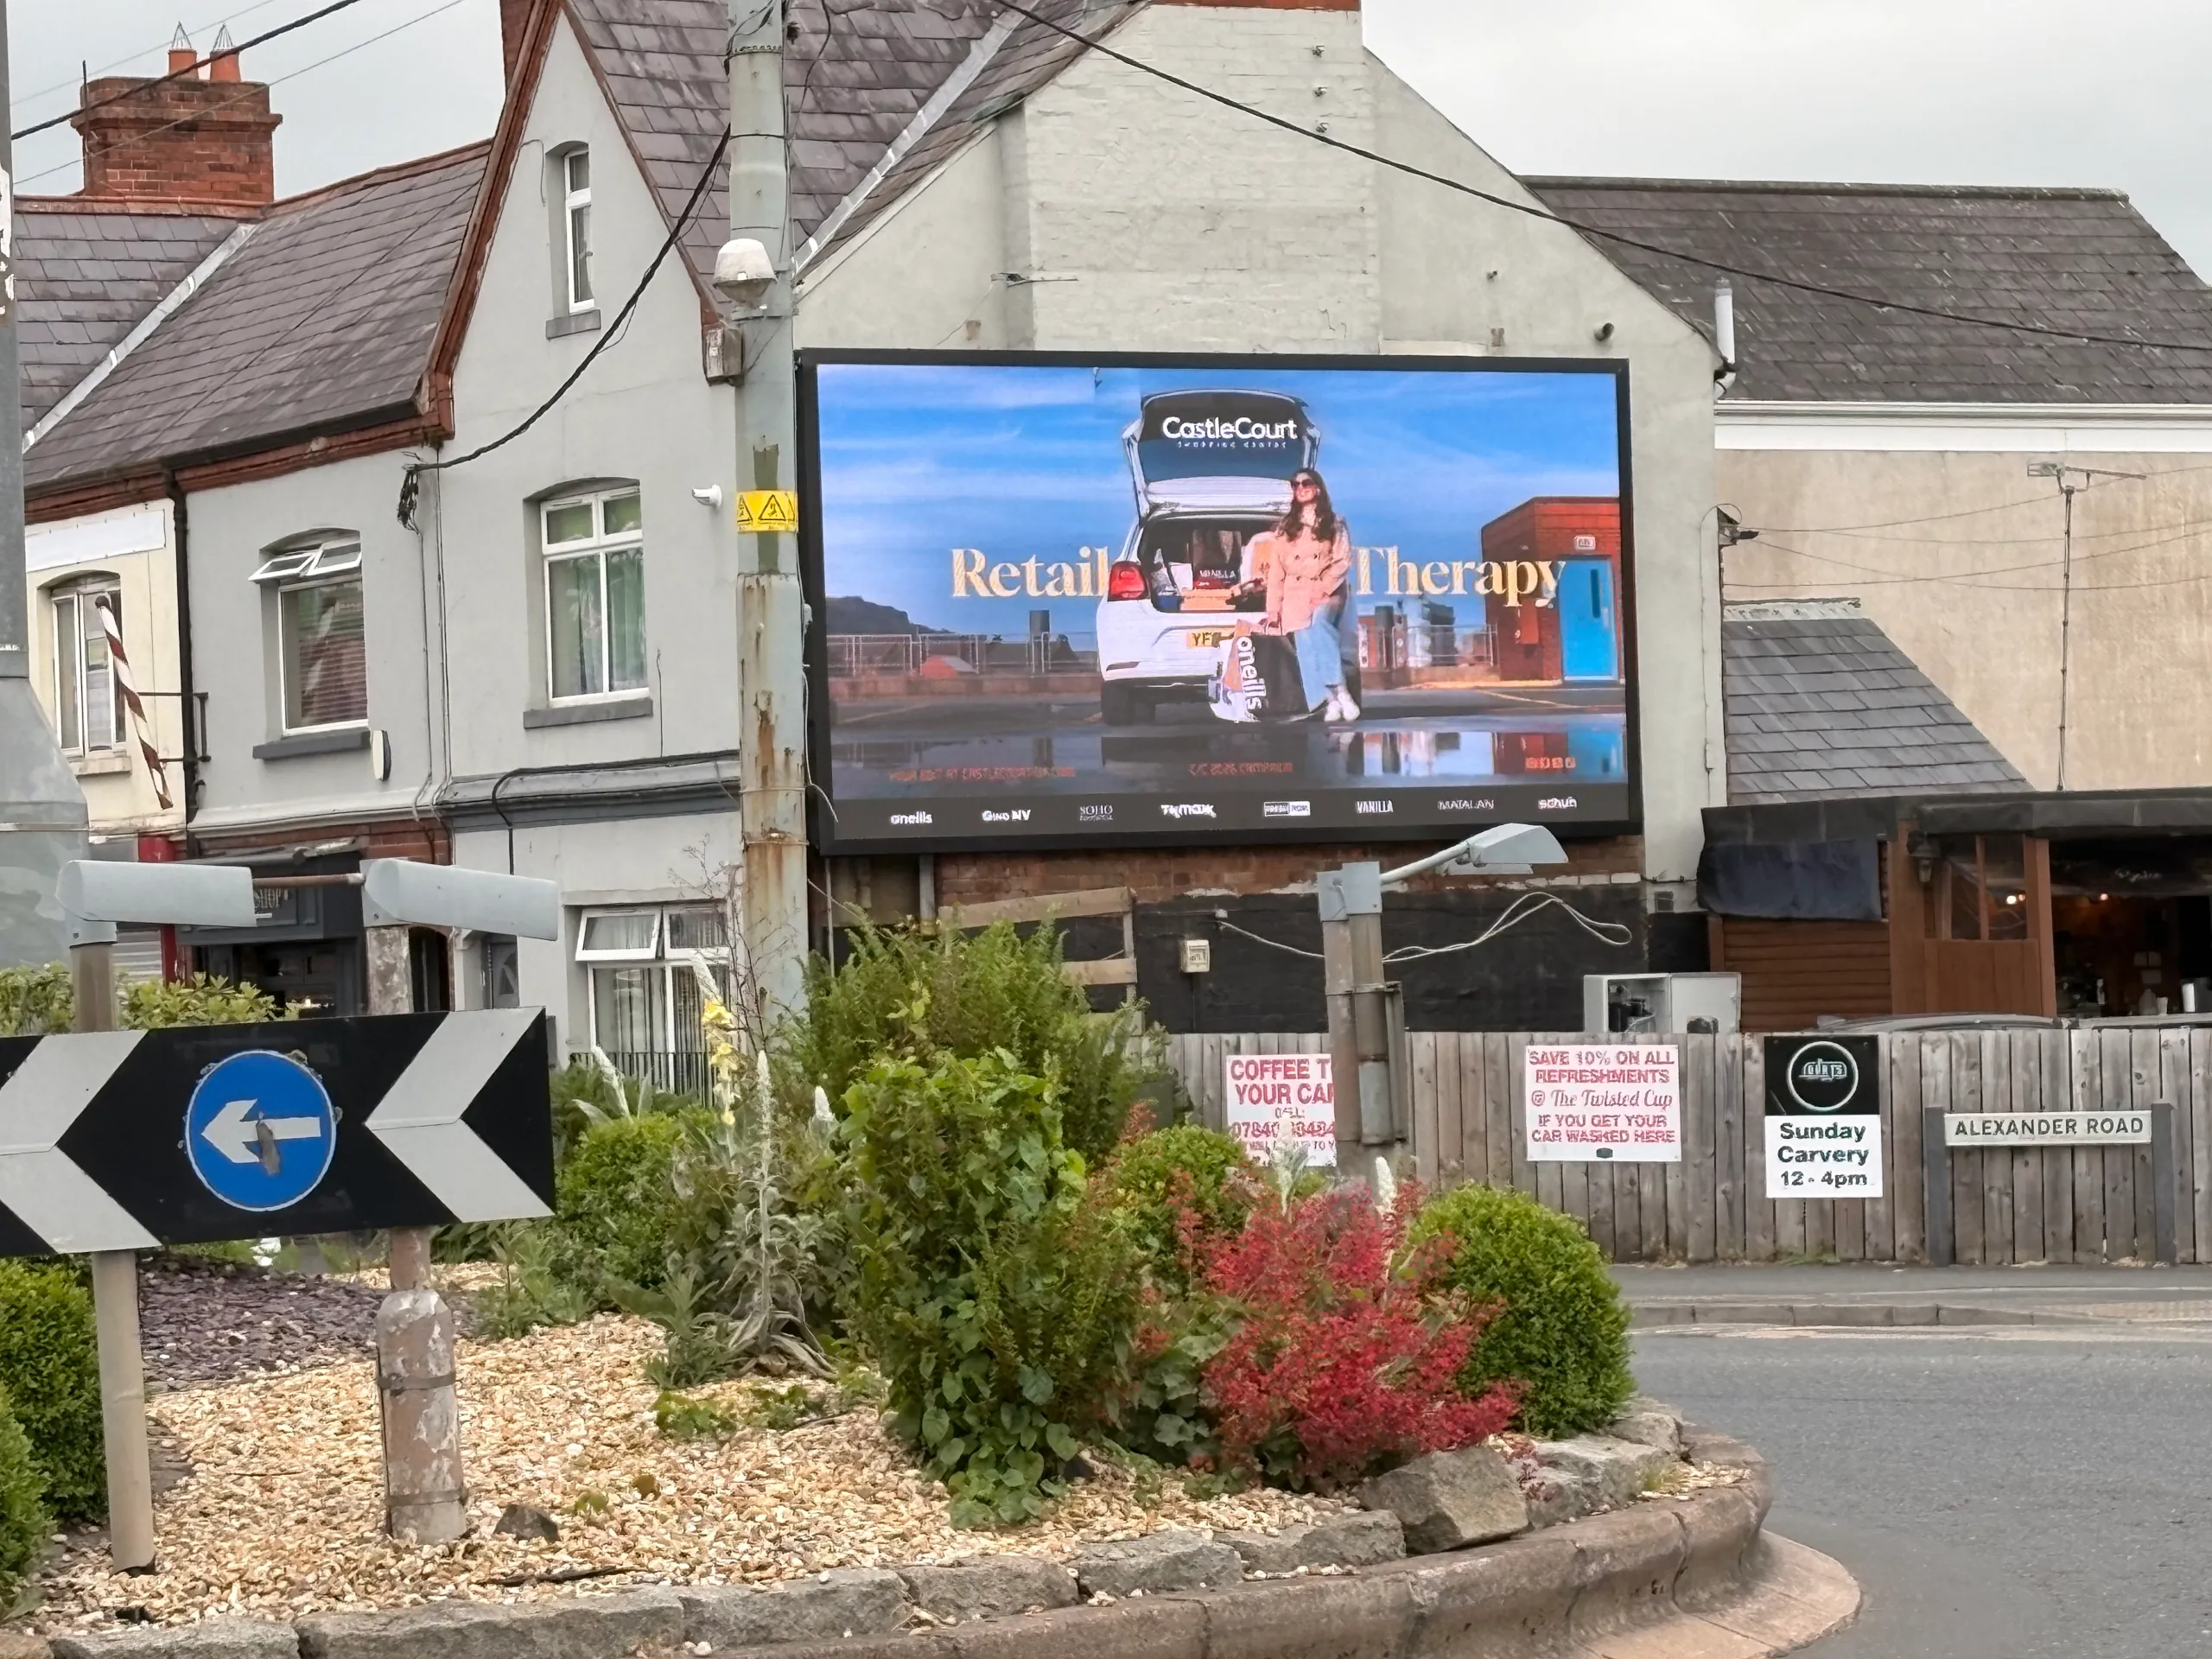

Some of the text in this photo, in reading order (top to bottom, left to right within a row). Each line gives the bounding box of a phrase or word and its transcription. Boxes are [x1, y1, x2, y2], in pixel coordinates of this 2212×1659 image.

[1162, 416, 1298, 439] CastleCourt
[951, 544, 1567, 608] Retail Therapy
[1356, 800, 1393, 814] VANILLA
[1437, 799, 1494, 810] MATALAN
[1529, 1051, 1675, 1065] SAVE 10% ON ALL
[1230, 1058, 1310, 1080] COFFEE
[1535, 1069, 1670, 1083] REFRESHMENTS
[1236, 1084, 1292, 1104] YOUR
[1551, 1090, 1577, 1107] The
[1582, 1090, 1640, 1107] Twisted
[1643, 1090, 1673, 1111] Cup
[1538, 1115, 1667, 1127] IF YOU GET YOUR
[1955, 1117, 2144, 1135] ALEXANDER ROAD
[1532, 1129, 1675, 1142] CAR WASHED HERE
[1780, 1122, 1866, 1142] Sunday
[1777, 1146, 1869, 1166] Carvery
[1821, 1171, 1867, 1188] 4pm
